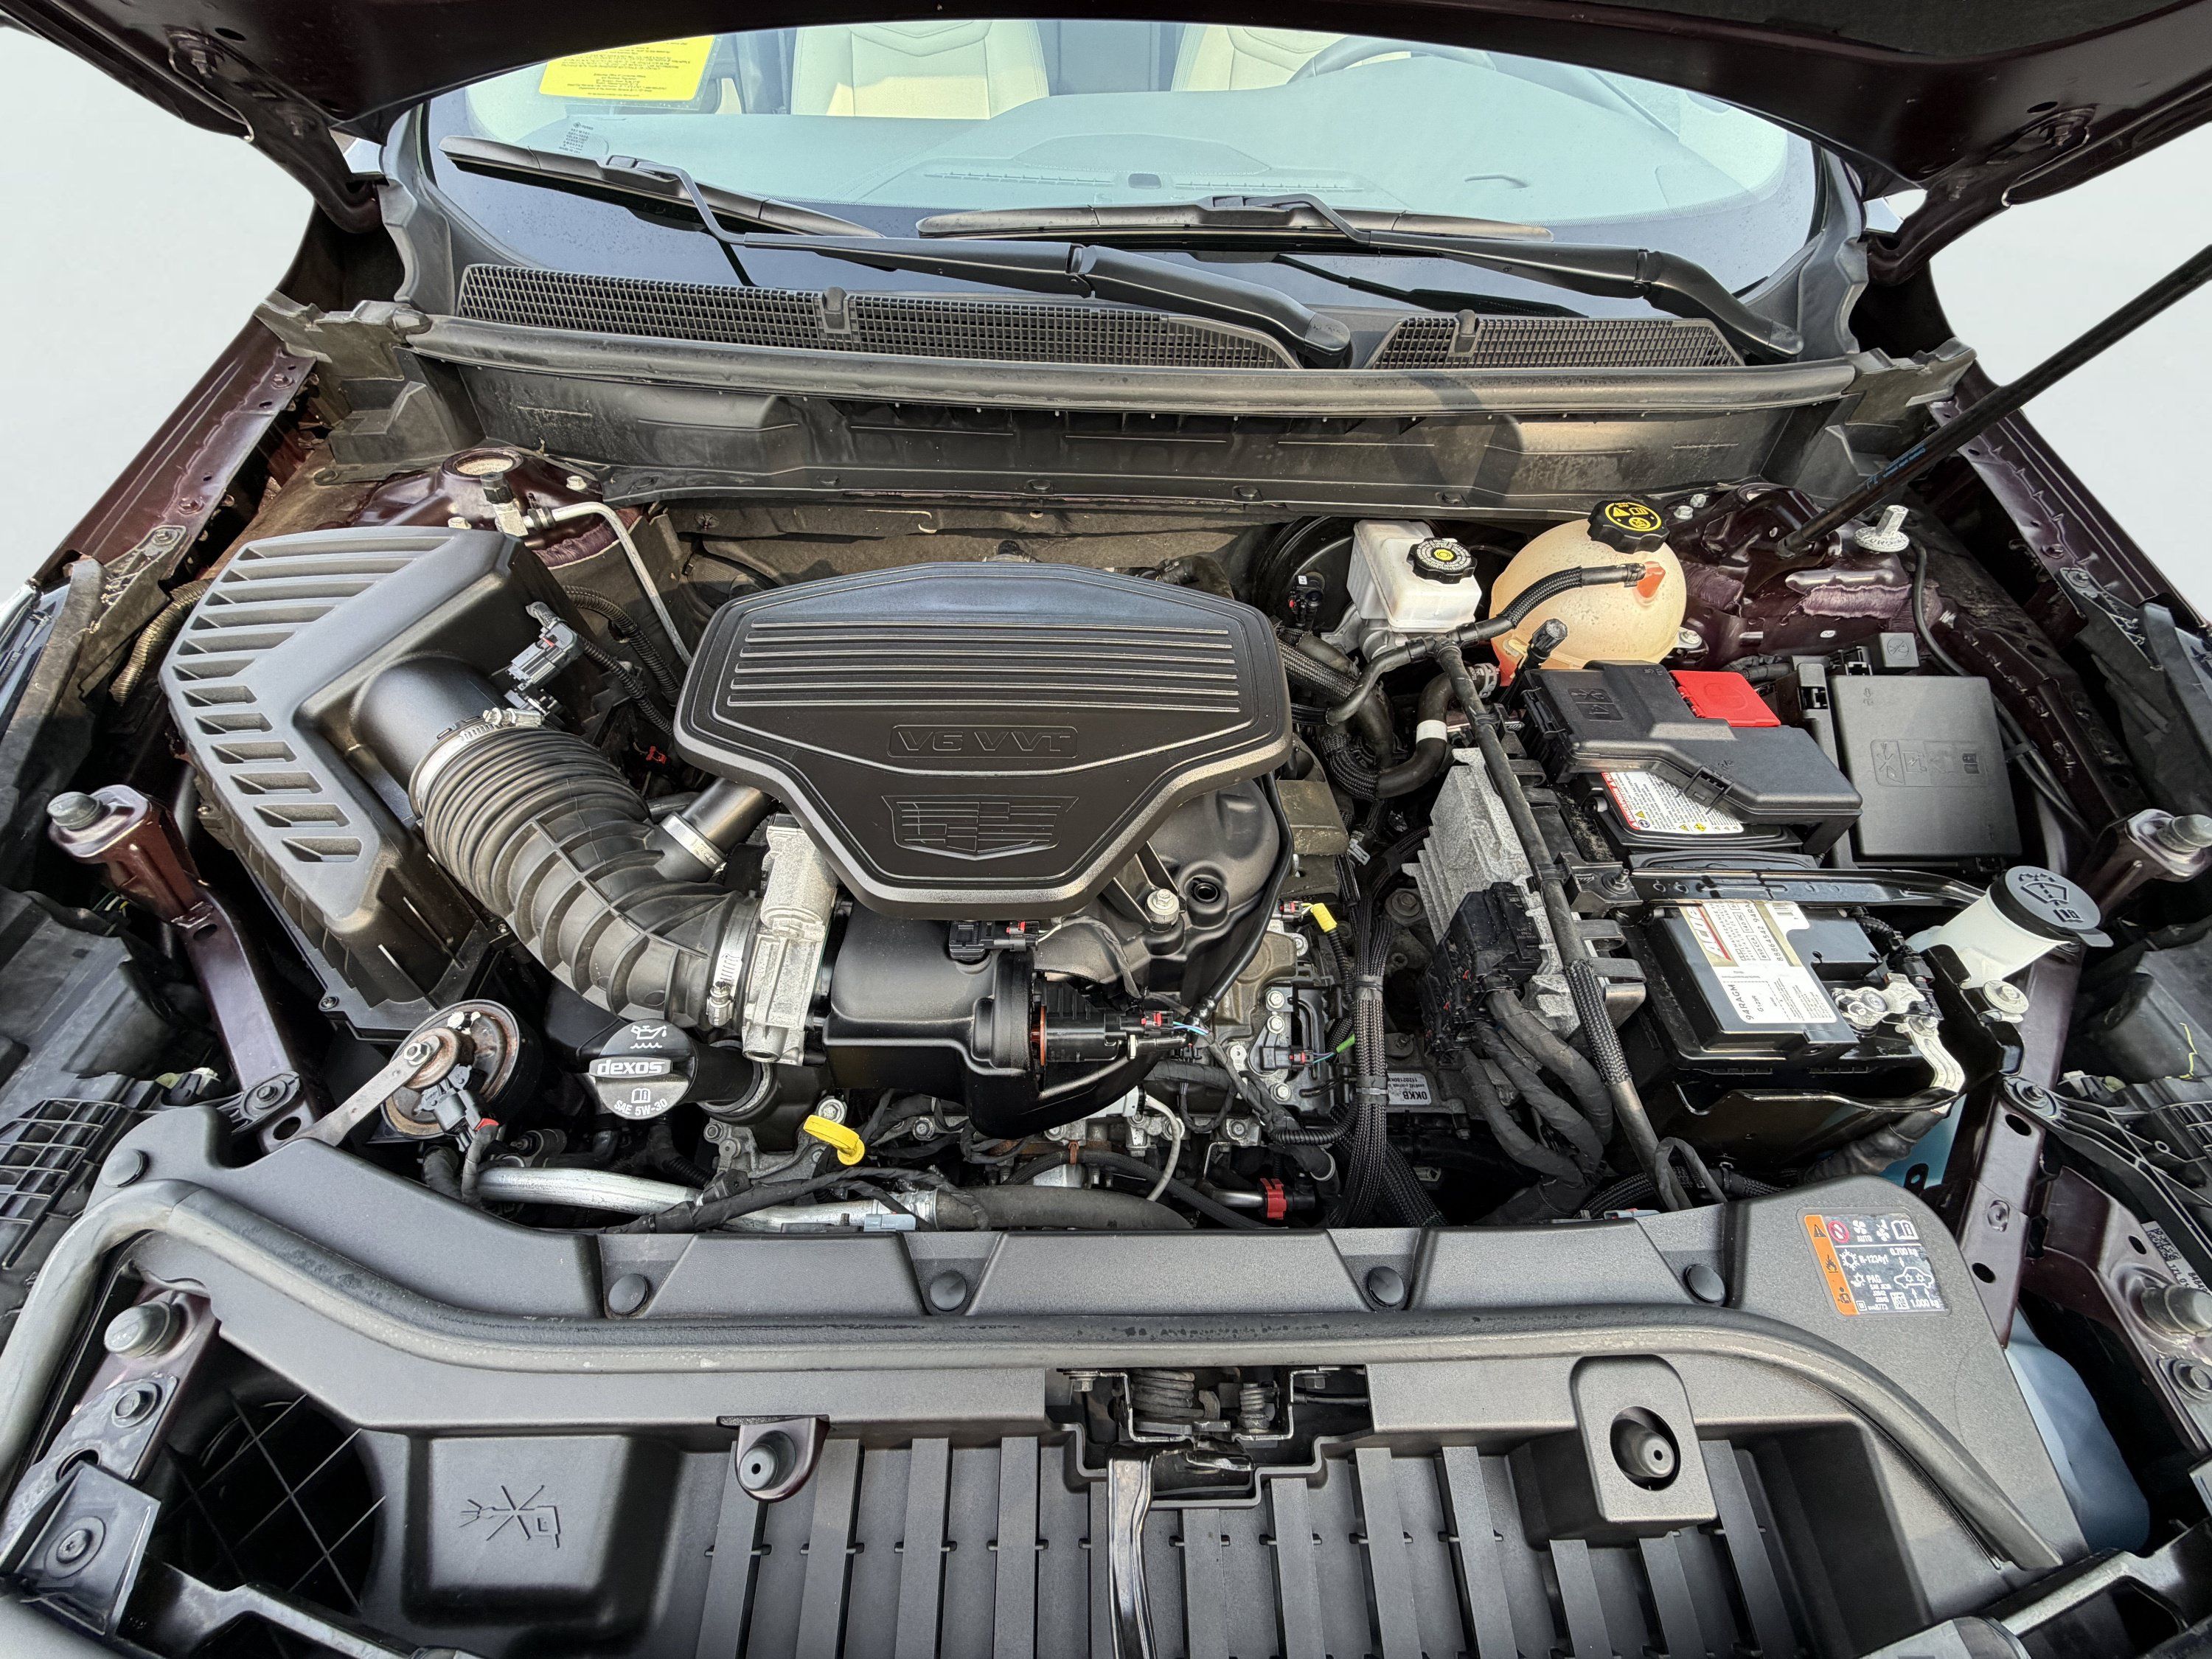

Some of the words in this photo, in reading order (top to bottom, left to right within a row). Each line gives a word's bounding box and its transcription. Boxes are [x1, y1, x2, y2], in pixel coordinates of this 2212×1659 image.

[898, 731, 964, 751] V6
[974, 731, 1071, 752] VVT
[1757, 925, 1784, 961] 88864542
[1728, 984, 1754, 1020] 94RAGM
[597, 1060, 666, 1076] dexos
[613, 1099, 633, 1116] SAE
[635, 1098, 668, 1116] 5W-30
[1889, 1248, 1910, 1256] 0.700
[1908, 1248, 1919, 1257] kg
[1865, 1274, 1882, 1284] PAG
[1910, 1298, 1930, 1308] 1.000
[1929, 1299, 1941, 1309] kg
